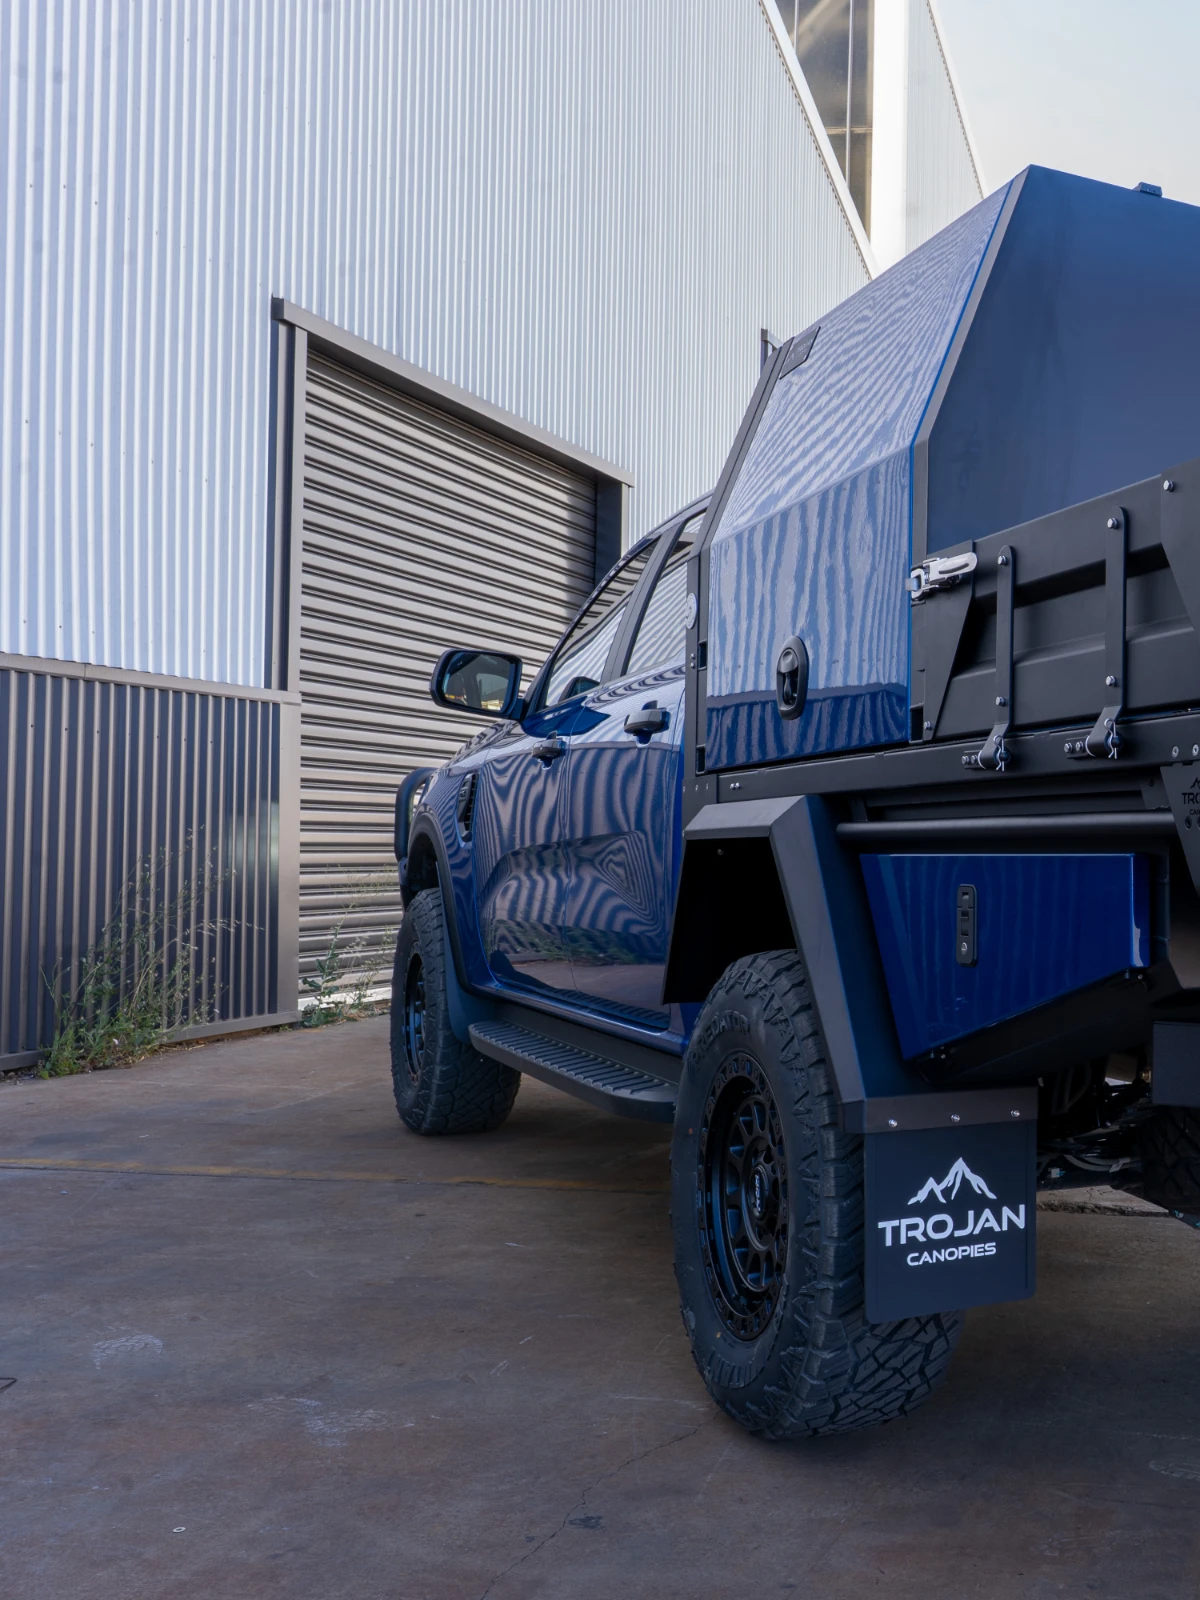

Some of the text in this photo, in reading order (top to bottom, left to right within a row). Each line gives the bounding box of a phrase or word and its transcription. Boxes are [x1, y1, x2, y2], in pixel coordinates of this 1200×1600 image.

[689, 1009, 751, 1064] PREDATOR
[877, 1203, 1026, 1247] TROJAN
[906, 1242, 997, 1266] CANOPIES
